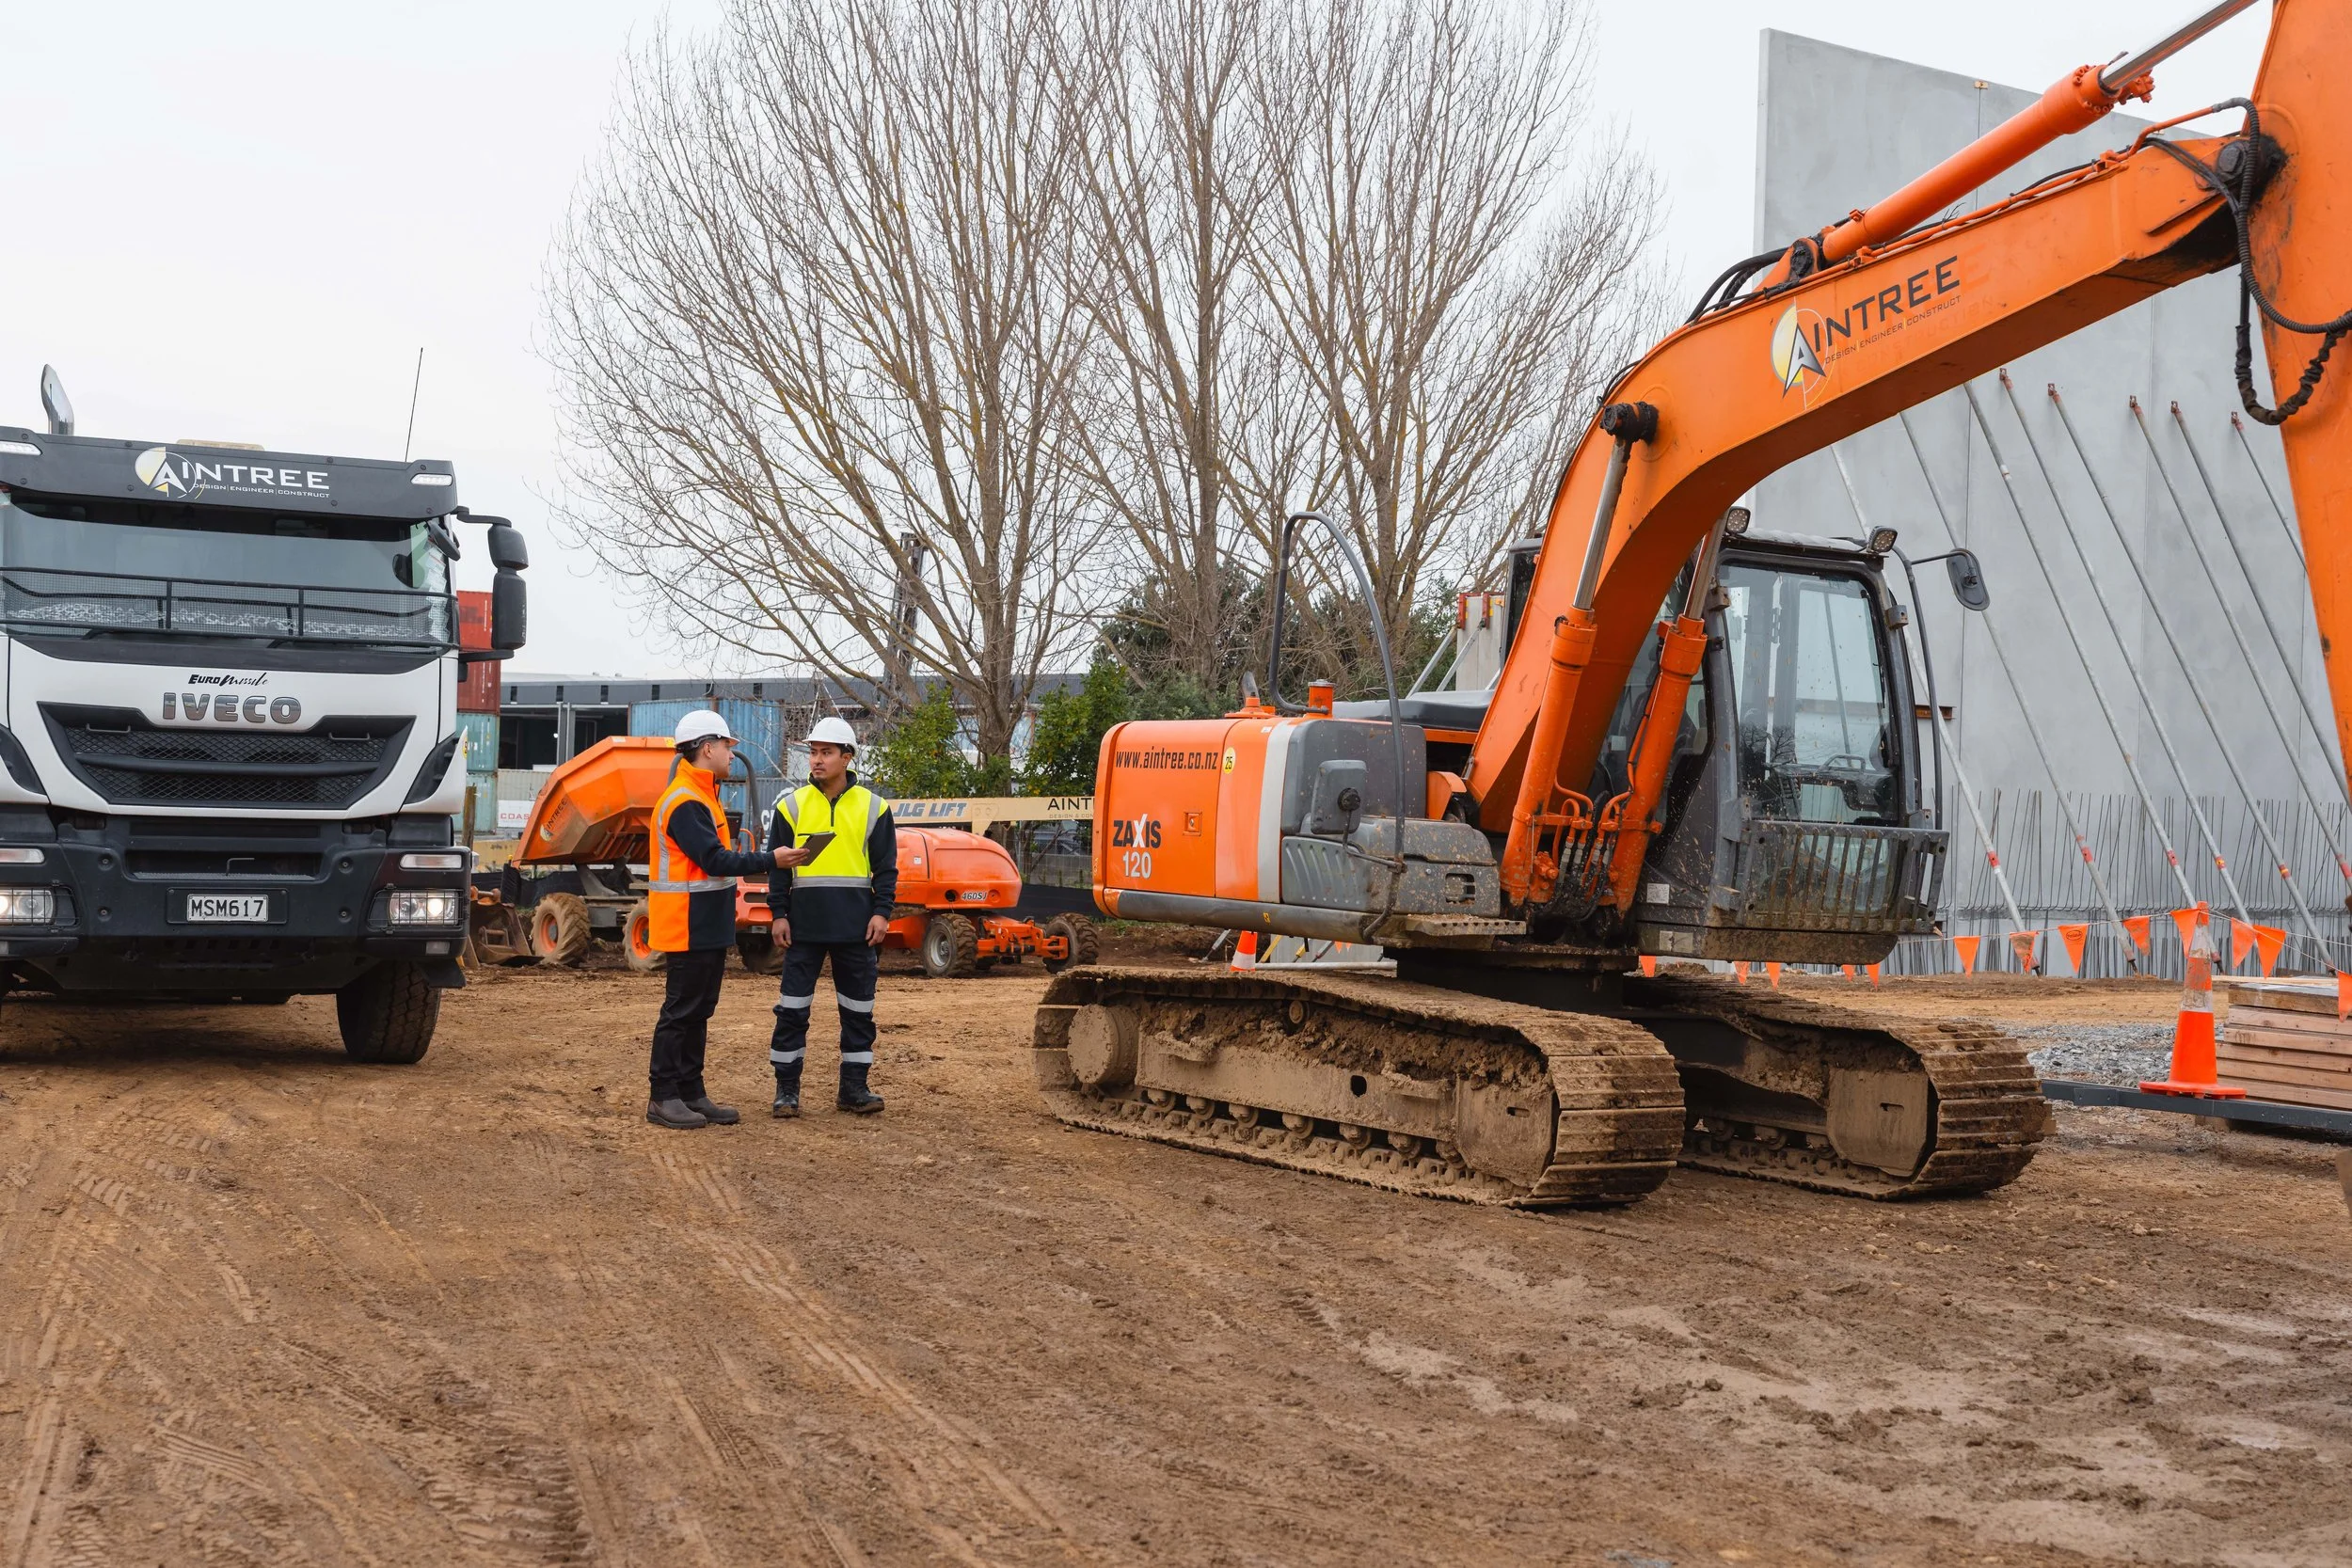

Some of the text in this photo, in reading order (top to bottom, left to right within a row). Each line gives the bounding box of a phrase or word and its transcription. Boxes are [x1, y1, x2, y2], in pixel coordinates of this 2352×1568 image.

[1782, 255, 1961, 398] AINTREE
[1824, 294, 1962, 365] DESIGN ENGINEER CONSTRUCT
[150, 460, 330, 494] AINTREE
[194, 483, 330, 499] DESIGN ENGINEER CONSTRUCT
[162, 691, 302, 725] IVECO
[1115, 746, 1218, 770] www.aintree.co.nz
[1225, 755, 1232, 770] 25
[892, 802, 967, 817] JLG LIFT
[1047, 797, 1094, 810] AINT
[1113, 813, 1162, 848] ZAXIS
[1122, 850, 1152, 879] 120
[191, 899, 264, 917] MSM617
[961, 892, 987, 901] 460SJ
